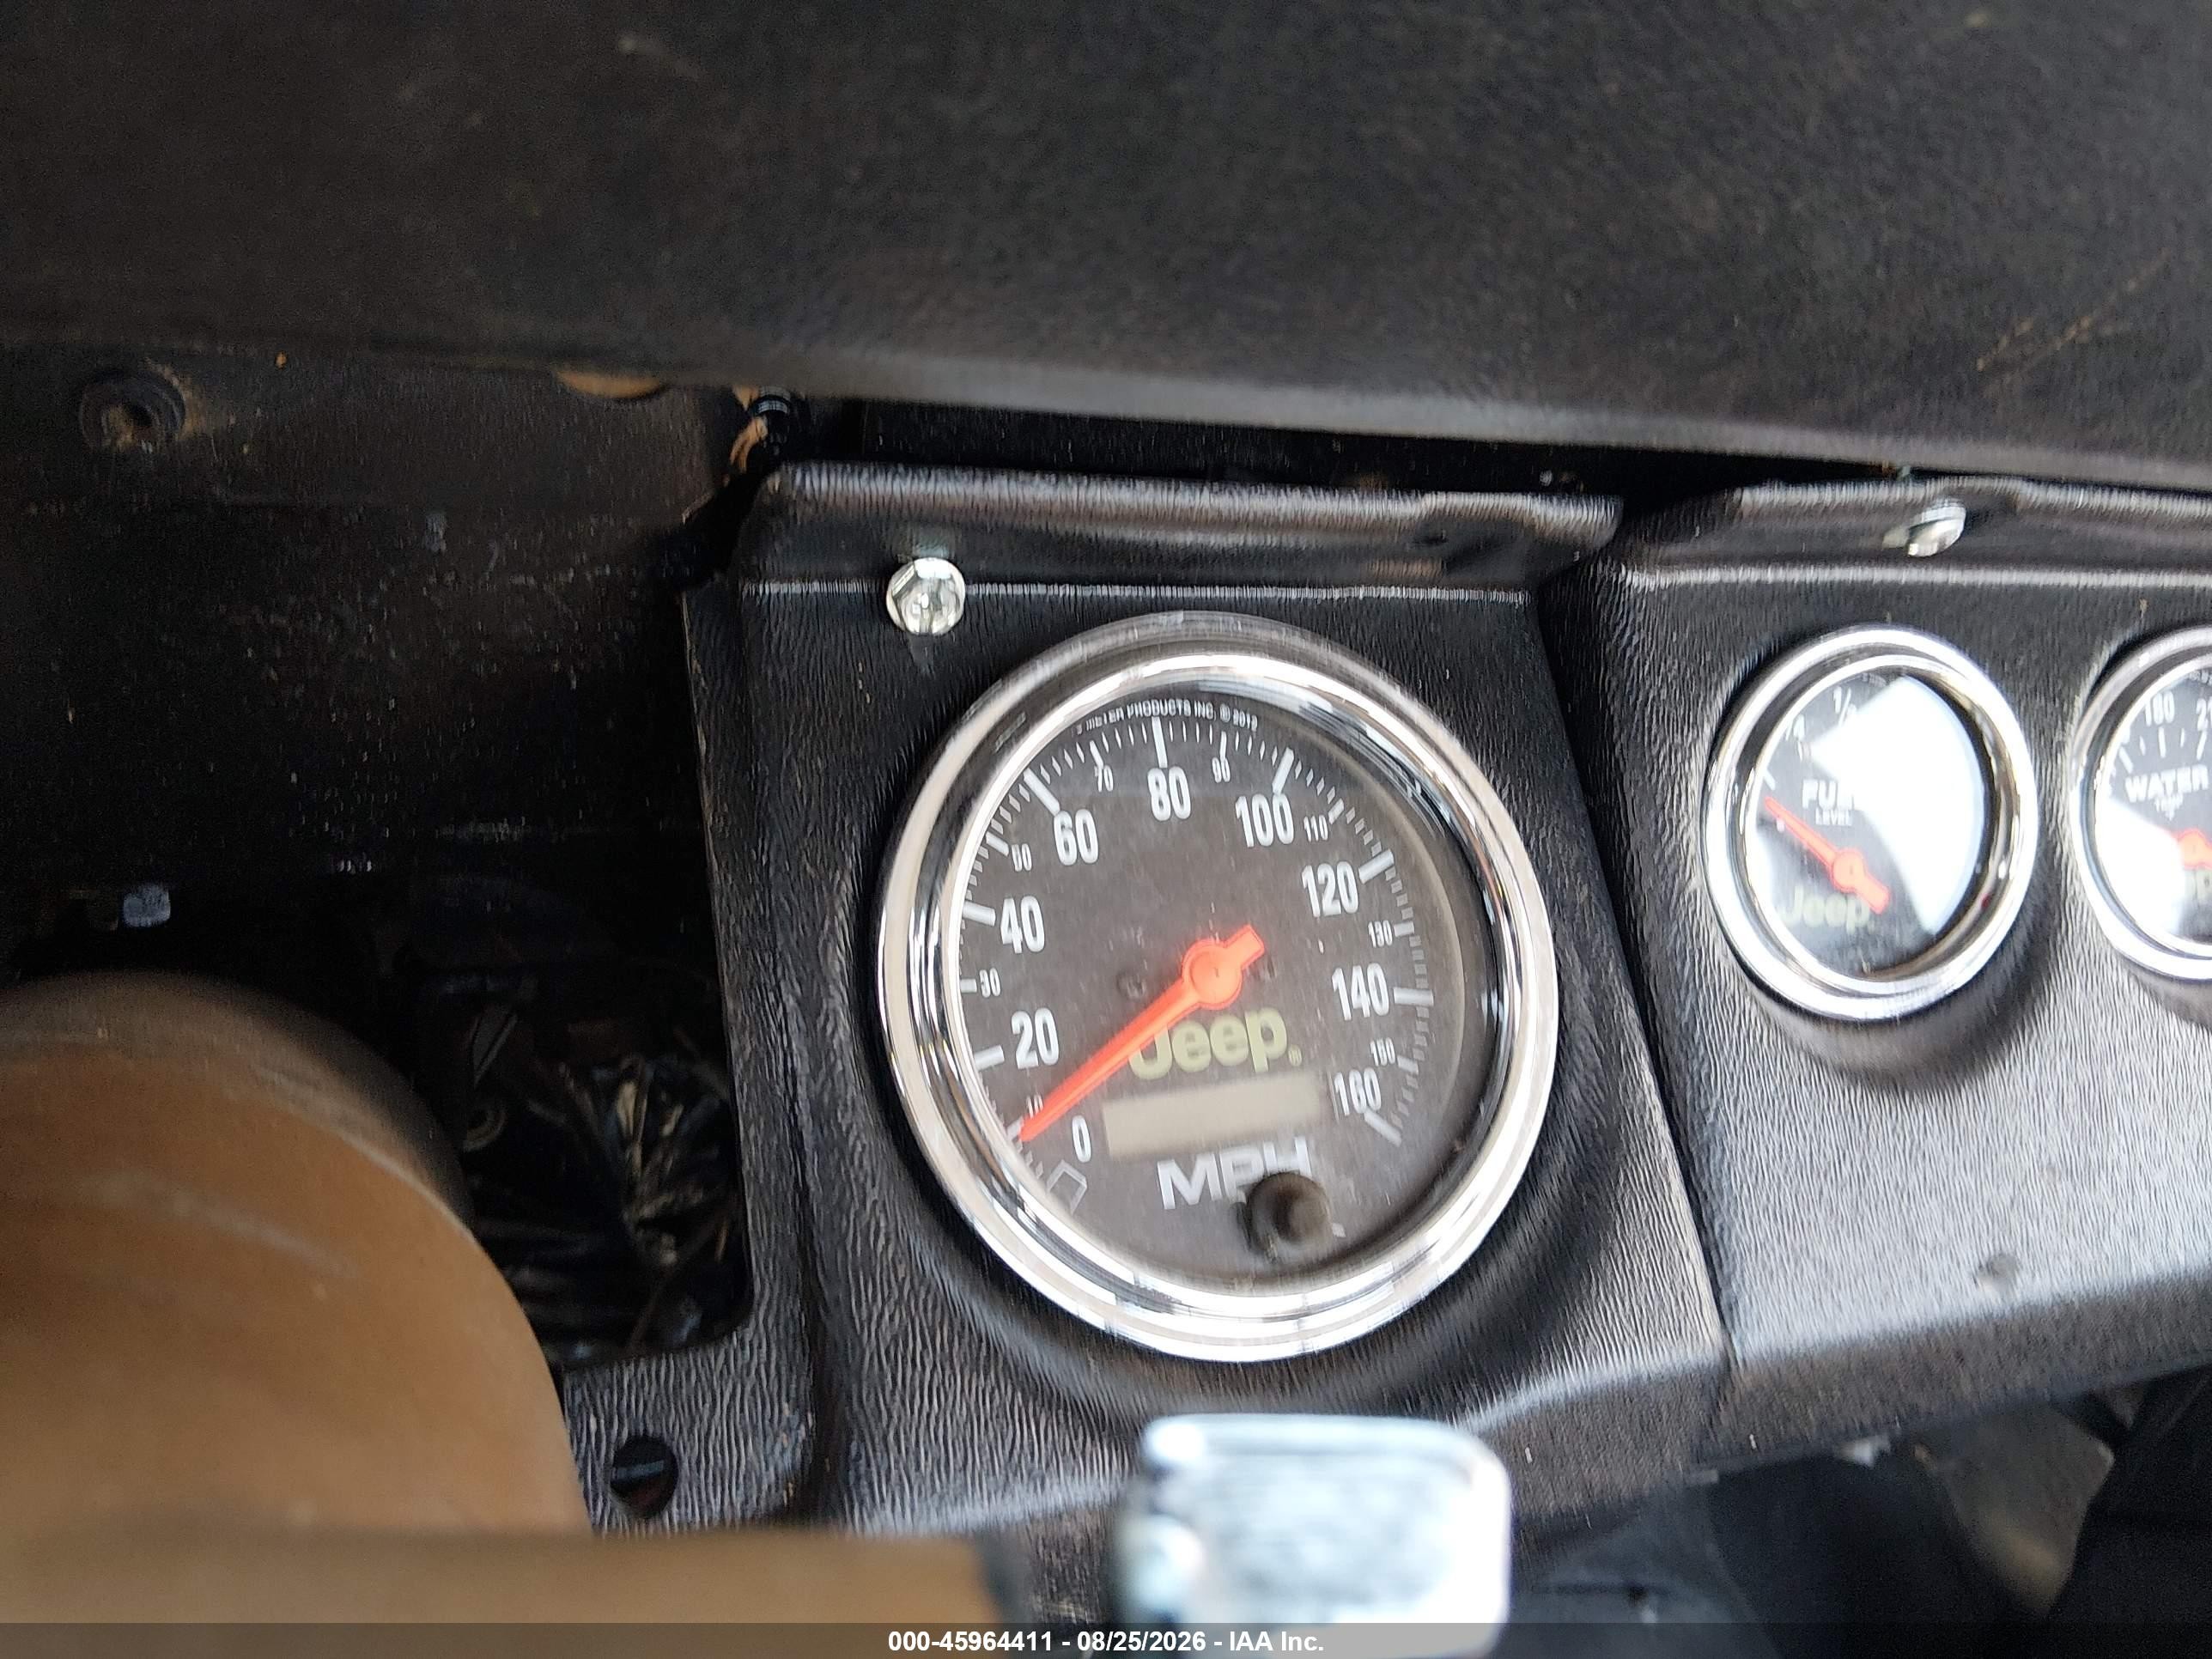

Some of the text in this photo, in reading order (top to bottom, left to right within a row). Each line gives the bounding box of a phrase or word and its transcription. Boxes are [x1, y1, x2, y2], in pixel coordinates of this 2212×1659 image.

[1094, 764, 1114, 793] 70
[1146, 766, 1191, 821] 80
[1212, 757, 1231, 783] 90
[2124, 763, 2209, 803] WATER
[1053, 808, 1099, 866] 60
[1235, 793, 1295, 848] 100
[1304, 814, 1328, 842] 110
[1301, 860, 1358, 918] 120
[1000, 895, 1045, 953] 40
[1368, 920, 1393, 948] 130
[979, 967, 1001, 998] 30
[1331, 962, 1389, 1021] 140
[1011, 1007, 1060, 1070] 20
[1370, 1036, 1395, 1067] 150
[1334, 1066, 1382, 1116] 160
[1072, 1115, 1091, 1163] 0
[1156, 1135, 1312, 1210] MPH
